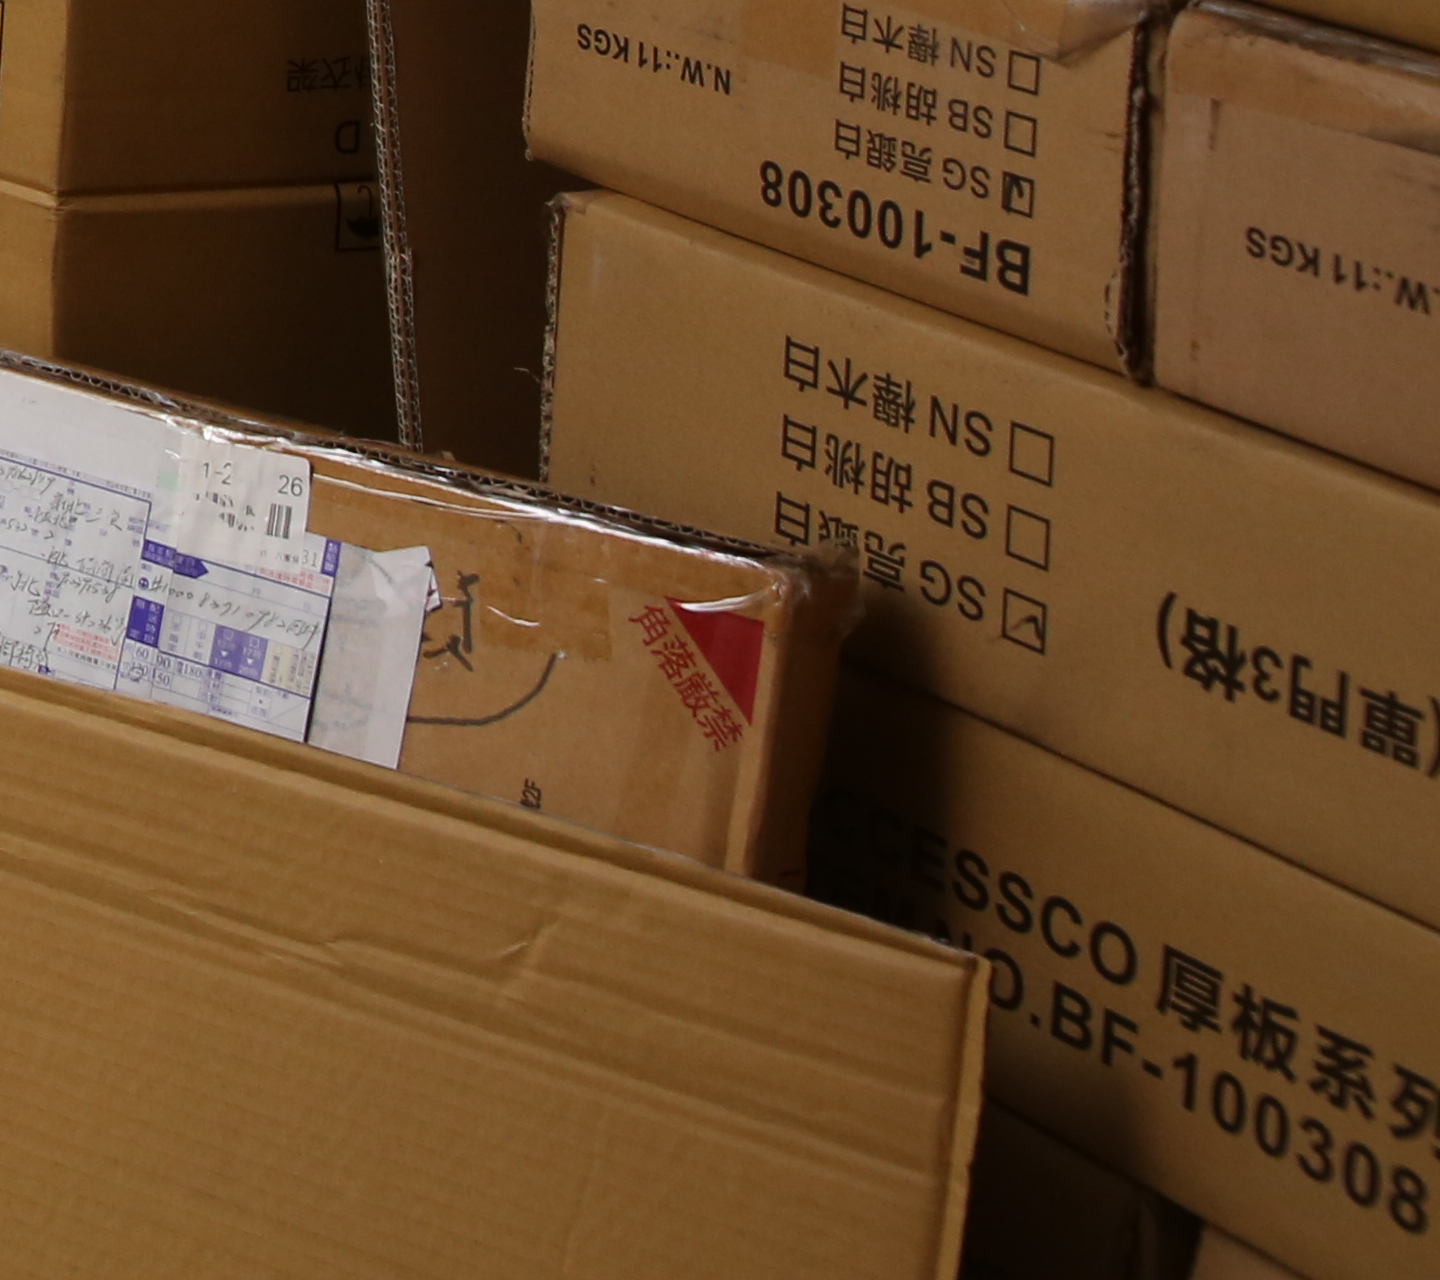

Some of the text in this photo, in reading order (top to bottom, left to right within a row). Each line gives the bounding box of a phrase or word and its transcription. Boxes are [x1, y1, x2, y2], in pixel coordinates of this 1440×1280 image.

[578, 24, 629, 63] KGS
[760, 161, 1030, 296] BF-100308
[1246, 227, 1320, 277] KGS
[930, 396, 993, 457] SN
[278, 474, 304, 496] 26
[782, 414, 989, 539] SB 胡桃白
[135, 647, 150, 661] 60
[811, 778, 1142, 988] CCESSCO
[980, 947, 1428, 1234] O.BF-100308
